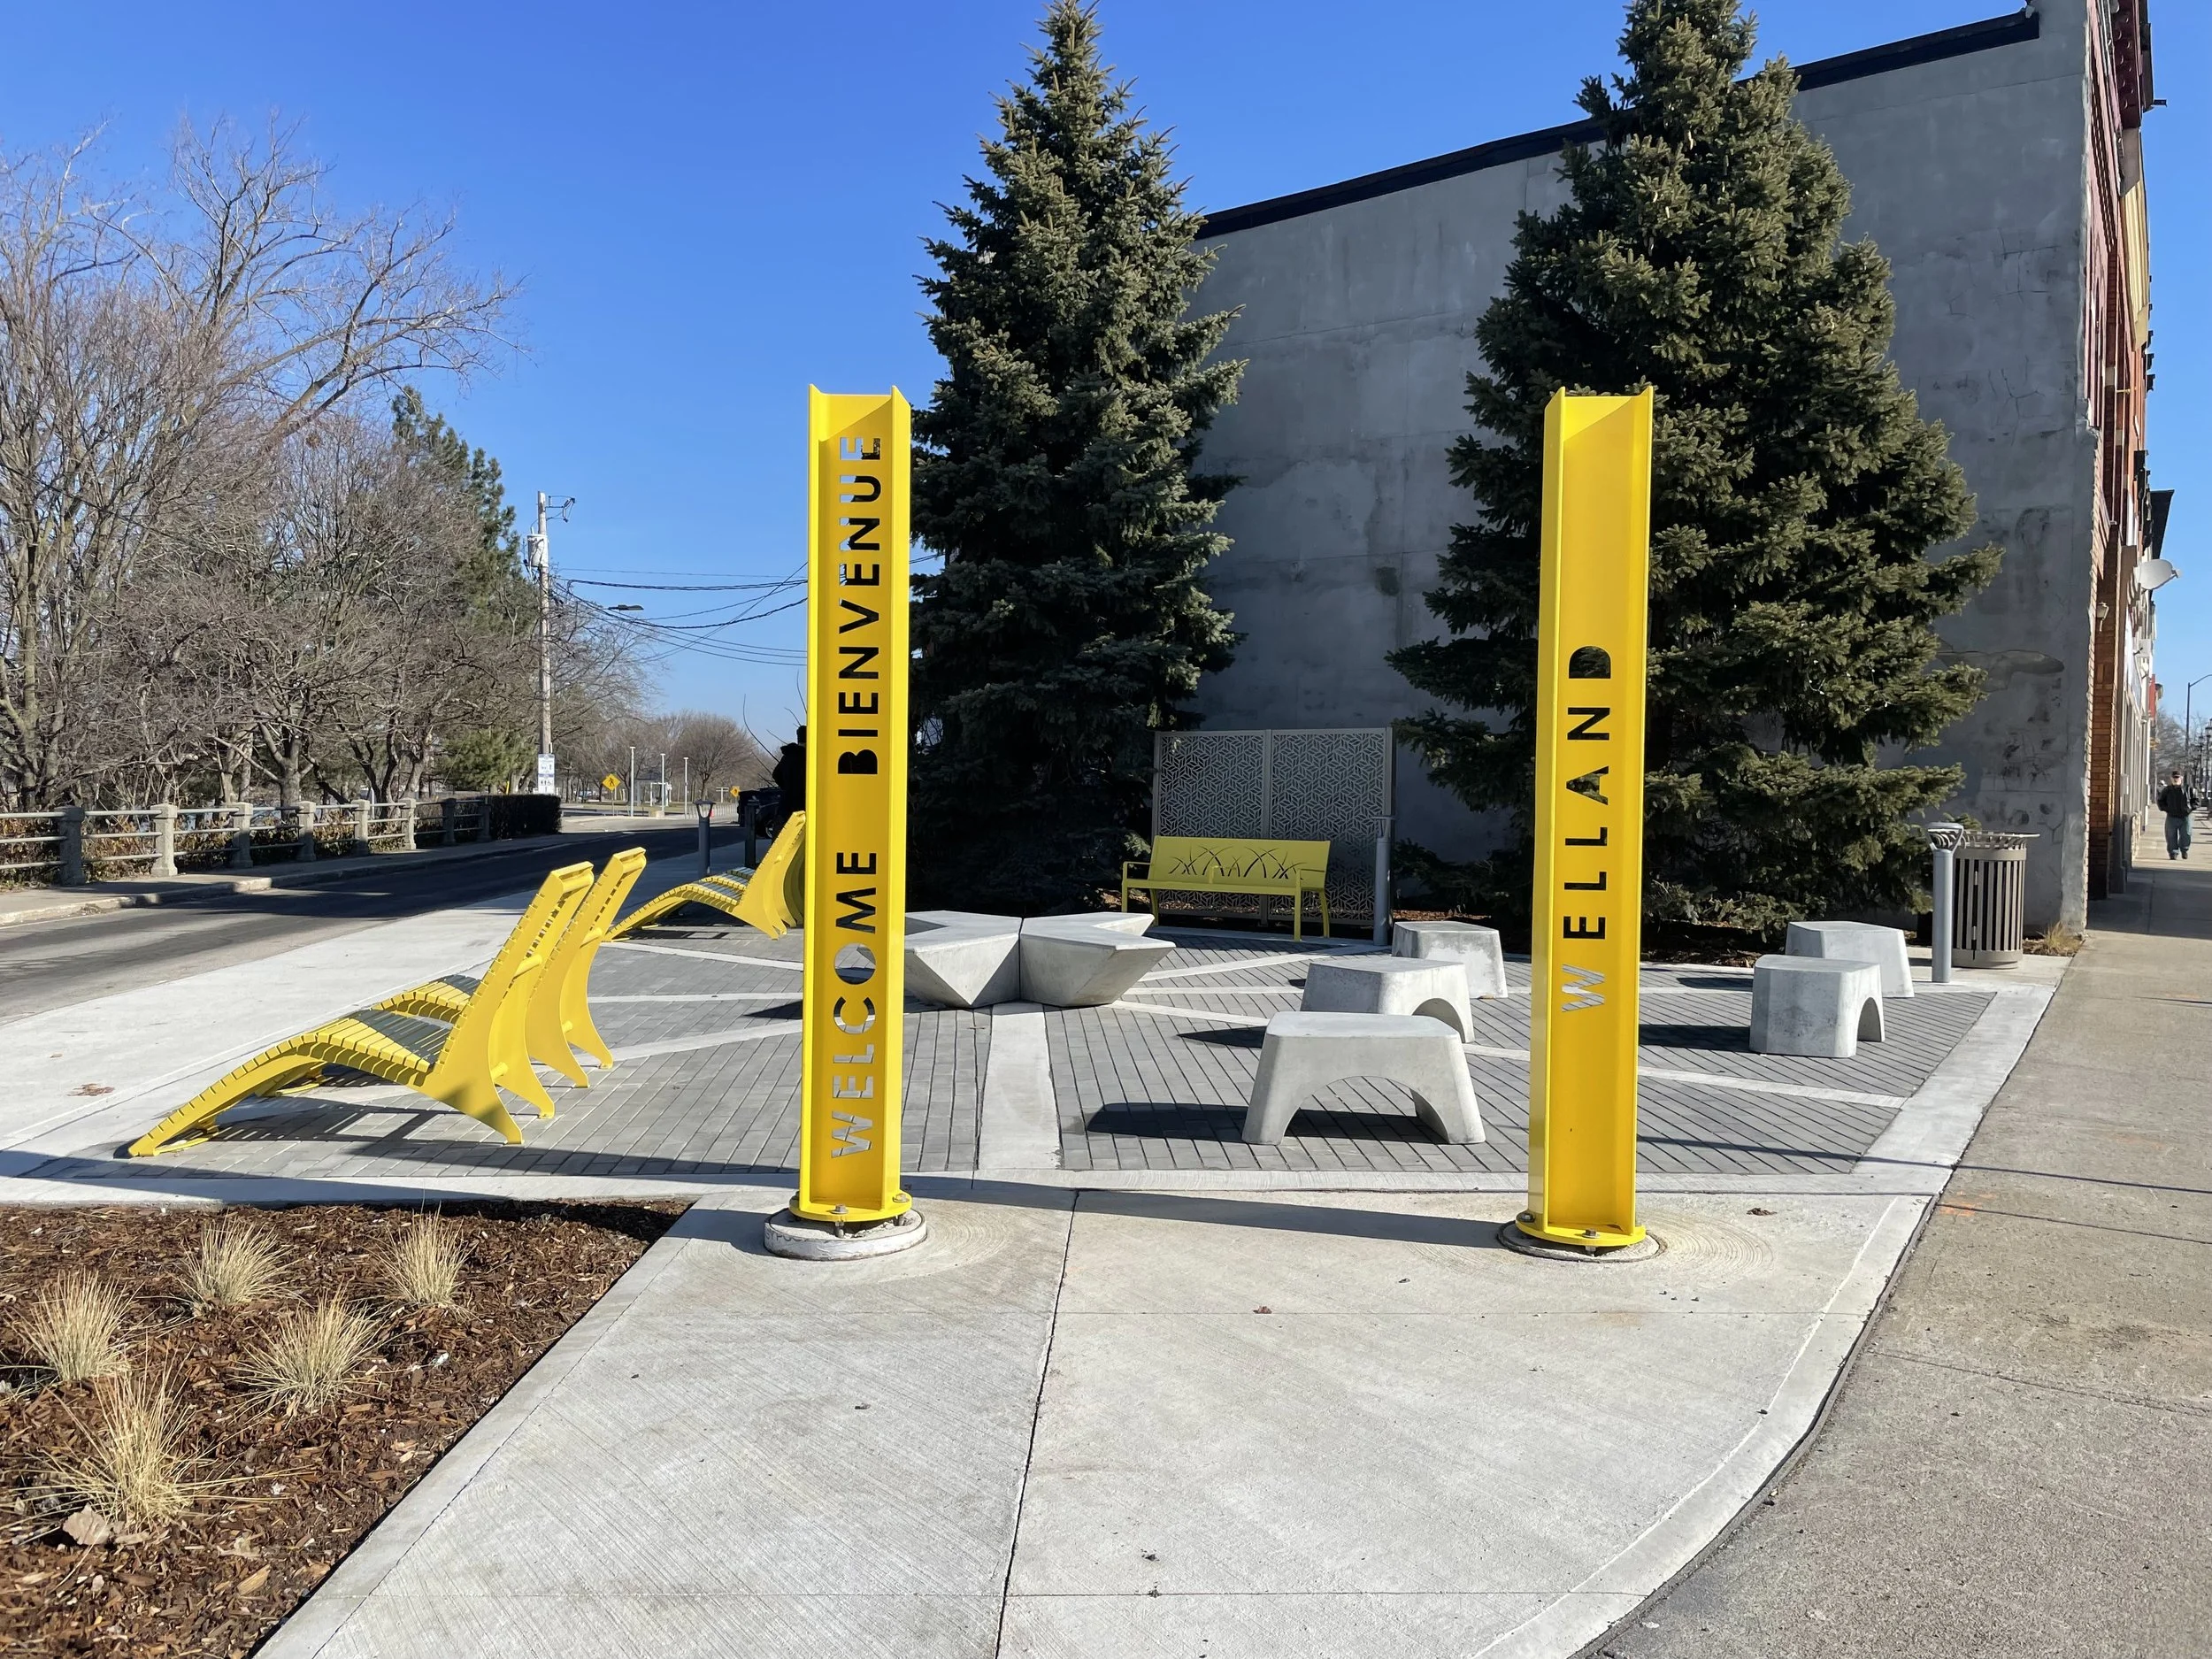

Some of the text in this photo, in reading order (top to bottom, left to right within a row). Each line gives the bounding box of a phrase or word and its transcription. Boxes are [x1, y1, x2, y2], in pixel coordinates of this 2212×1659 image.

[832, 435, 882, 1159] WELCOME BIENVENUE
[1561, 645, 1612, 1013] WELLAND
